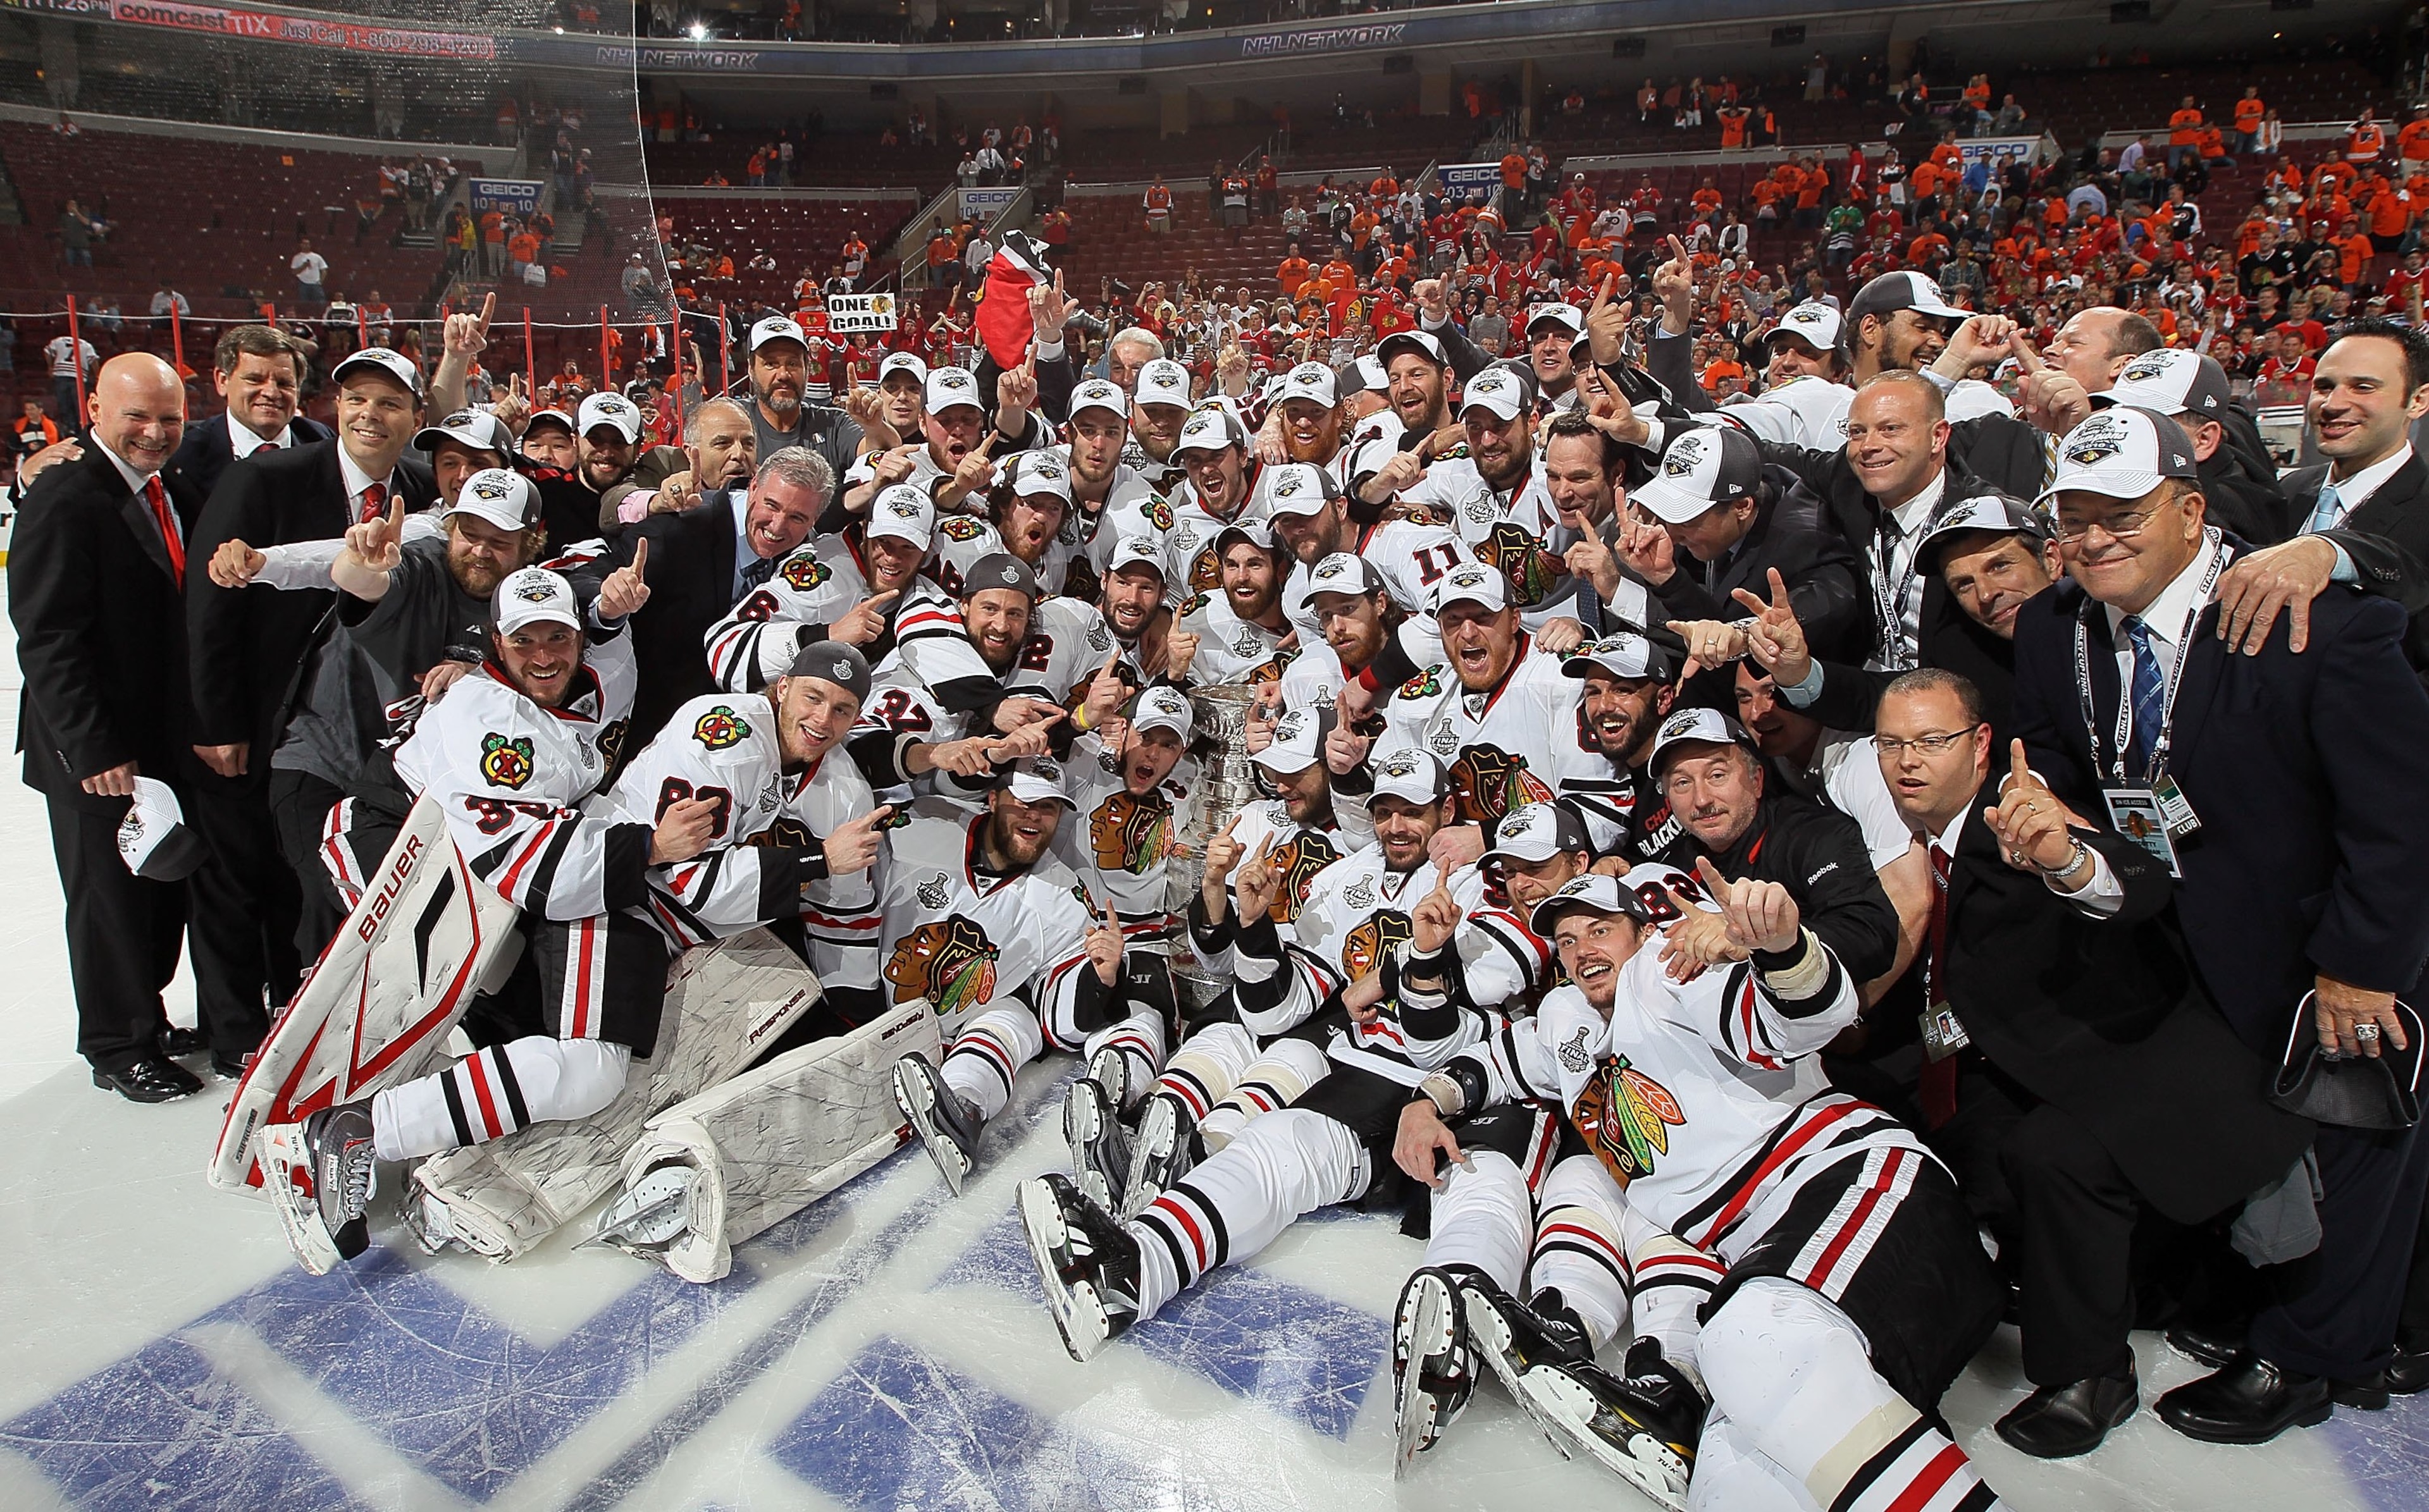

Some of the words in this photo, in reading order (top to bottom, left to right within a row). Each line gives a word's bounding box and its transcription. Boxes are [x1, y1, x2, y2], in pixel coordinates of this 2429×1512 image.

[280, 21, 312, 39] Just
[316, 27, 345, 44] Call
[352, 30, 489, 55] 1-800-298-4200
[479, 183, 536, 197] GEICO
[1447, 185, 1465, 199] 03
[960, 206, 980, 218] 104
[831, 298, 870, 312] ONE
[832, 316, 891, 330] GOAL!
[1465, 503, 1495, 518] FINAL
[1175, 534, 1201, 543] FINAL
[1412, 543, 1461, 586] 11
[736, 589, 779, 622] 6
[1087, 630, 1111, 646] FINAL
[1233, 641, 1264, 650] FINAL
[874, 688, 932, 732] 37
[2117, 708, 2128, 746] STANLEY
[761, 791, 781, 803] FINAL
[2177, 818, 2197, 835] CLUB
[1807, 861, 1839, 885] Reebok
[357, 834, 424, 943] BAUER
[919, 883, 949, 904] FINAL
[1344, 886, 1376, 902] FINAL
[749, 989, 806, 1045] RESPONSE
[881, 1009, 925, 1041] RESPONSE
[1559, 1042, 1590, 1064] FINAL
